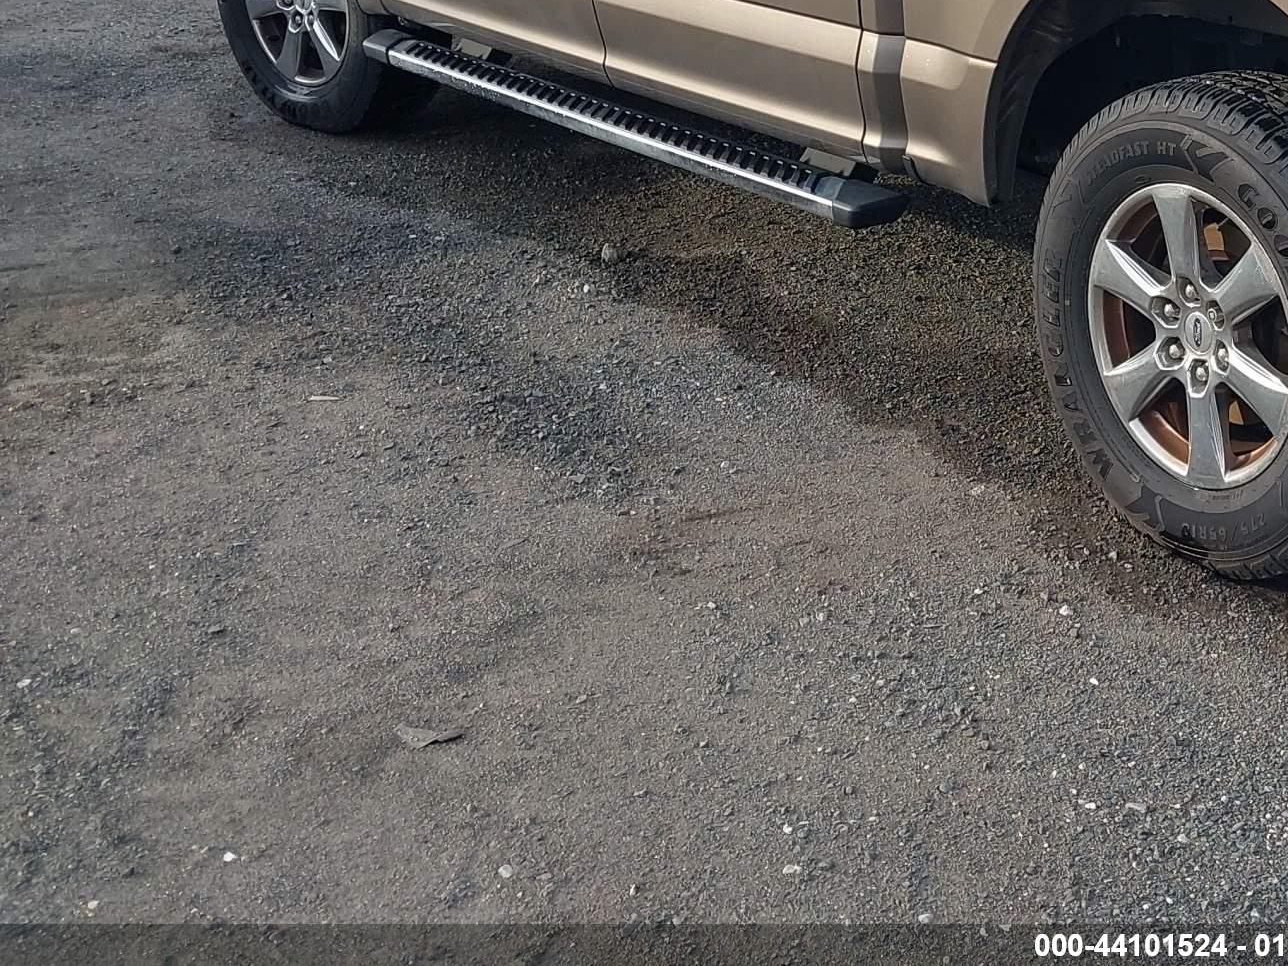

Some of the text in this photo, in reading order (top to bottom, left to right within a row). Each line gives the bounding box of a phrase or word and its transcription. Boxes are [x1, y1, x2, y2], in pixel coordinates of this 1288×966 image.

[1085, 140, 1176, 186] STEADFAST HT
[1041, 246, 1114, 481] WRANGLER
